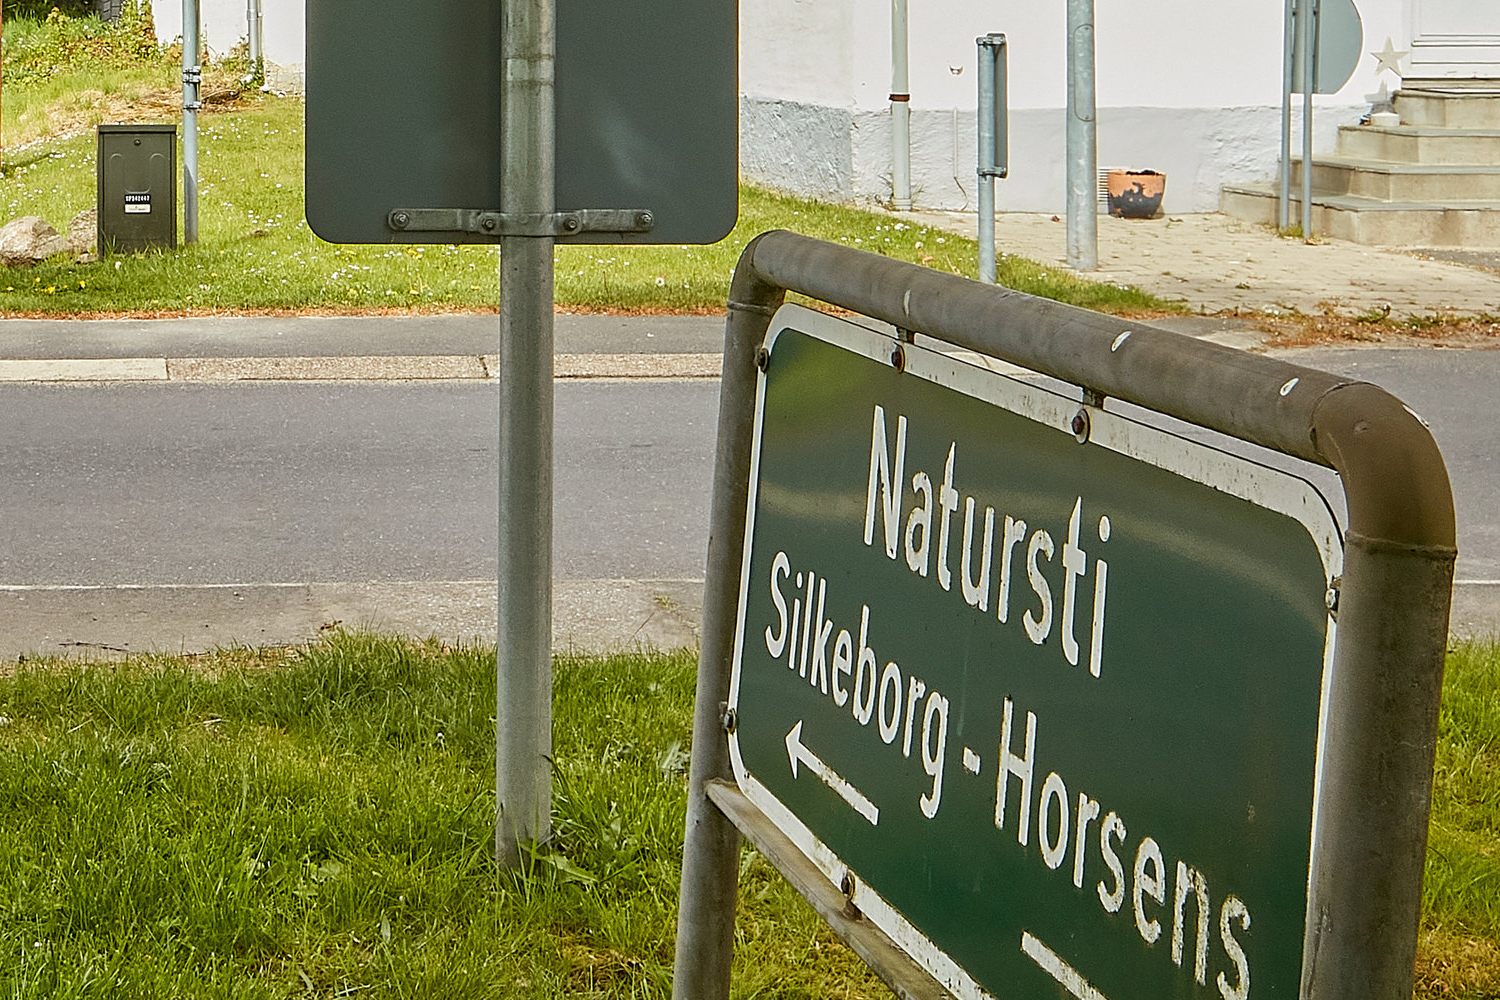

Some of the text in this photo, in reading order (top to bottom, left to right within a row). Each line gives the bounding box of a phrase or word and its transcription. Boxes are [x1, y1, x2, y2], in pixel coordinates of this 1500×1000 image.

[863, 404, 1111, 679] Natursti
[764, 551, 1252, 1000] Silkeborg - Horsens
